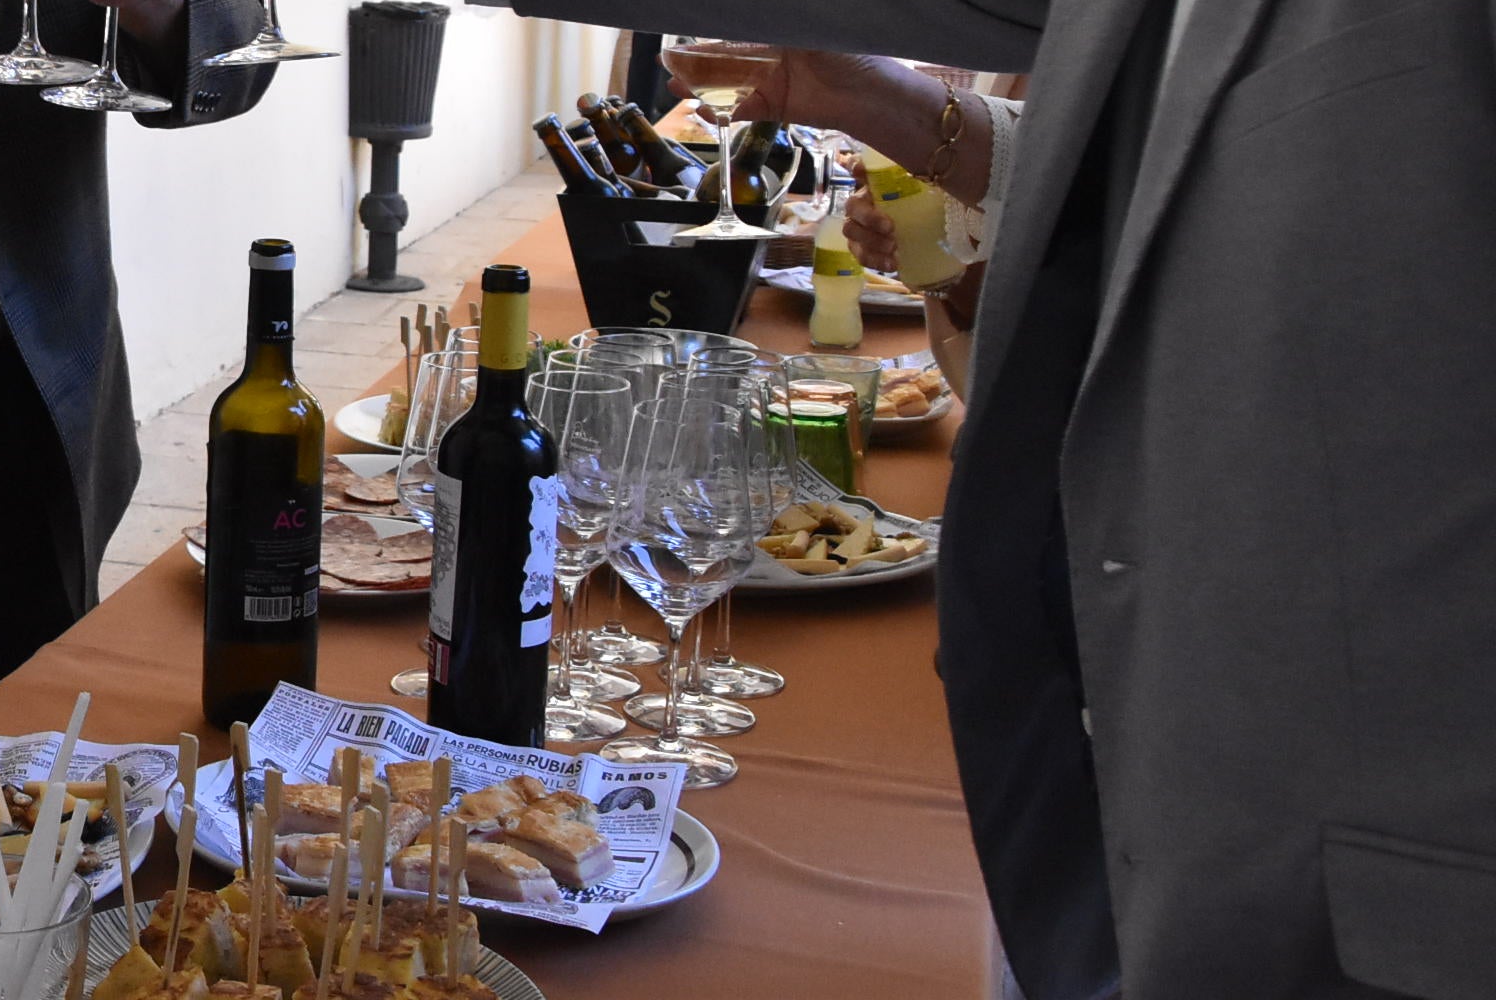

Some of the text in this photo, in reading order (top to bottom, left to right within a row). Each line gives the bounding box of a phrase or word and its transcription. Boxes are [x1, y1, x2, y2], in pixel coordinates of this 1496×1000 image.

[273, 508, 307, 530] AC
[336, 712, 355, 734] LA
[355, 714, 384, 738] BIEN
[383, 719, 430, 756] PAGADA
[443, 736, 583, 775] LAS PERSONAS RUBIAS
[601, 771, 668, 781] RAMOS
